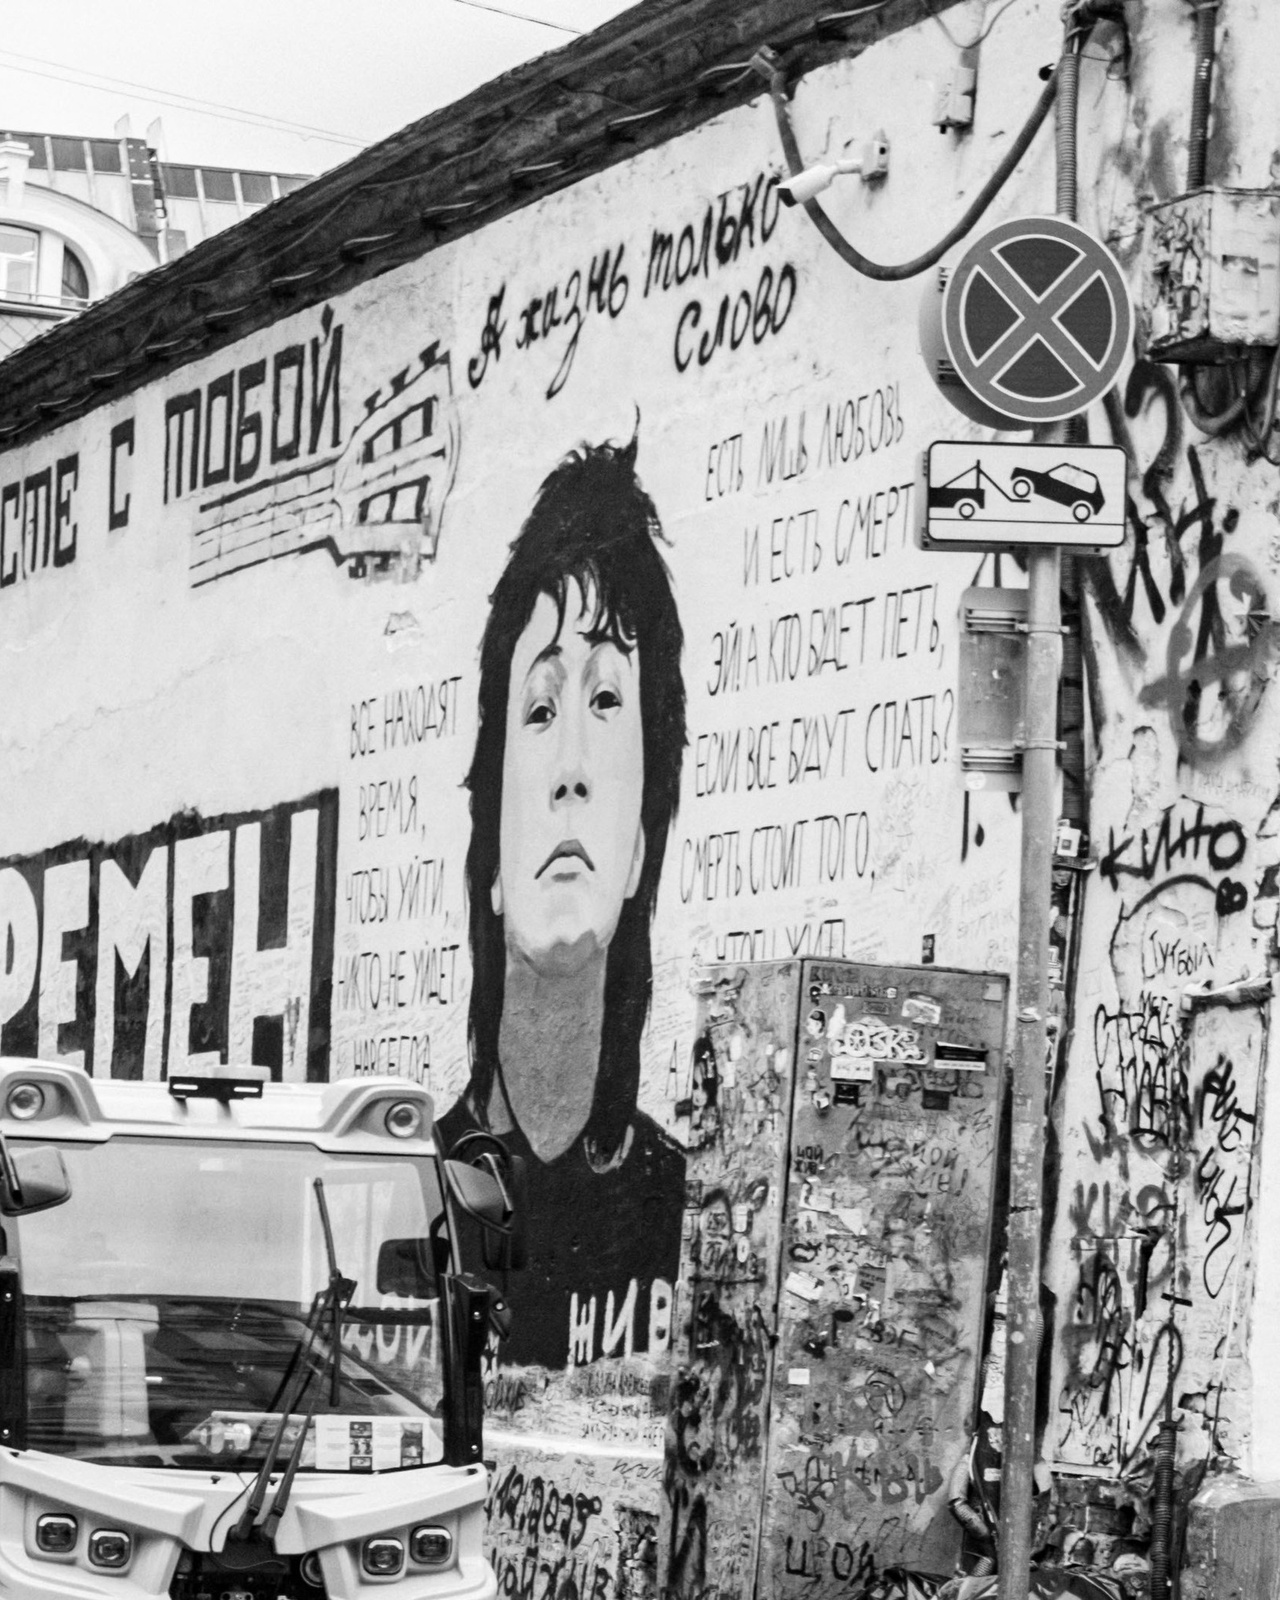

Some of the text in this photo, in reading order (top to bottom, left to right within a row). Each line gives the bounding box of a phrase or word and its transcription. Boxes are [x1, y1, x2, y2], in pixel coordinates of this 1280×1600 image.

[108, 418, 136, 532] С
[165, 303, 344, 505] ТОБОЙ
[706, 433, 744, 501] ЕСТЬ
[816, 381, 905, 469] ЛЮБОВЬ
[743, 483, 916, 587] И ЕСТЬ СМЕРТ
[766, 613, 802, 683] КТО
[350, 676, 463, 760] ВСЕ НАХОДЯТ
[746, 721, 780, 792] ВСЕ
[864, 688, 955, 773] СПАТЬ?
[680, 830, 743, 904] СМЕРТЬ
[1100, 802, 1247, 892] КИНО
[345, 867, 389, 925] ЧТОБЫ
[336, 951, 382, 1011] НИКТО
[387, 950, 407, 1009] НЕ
